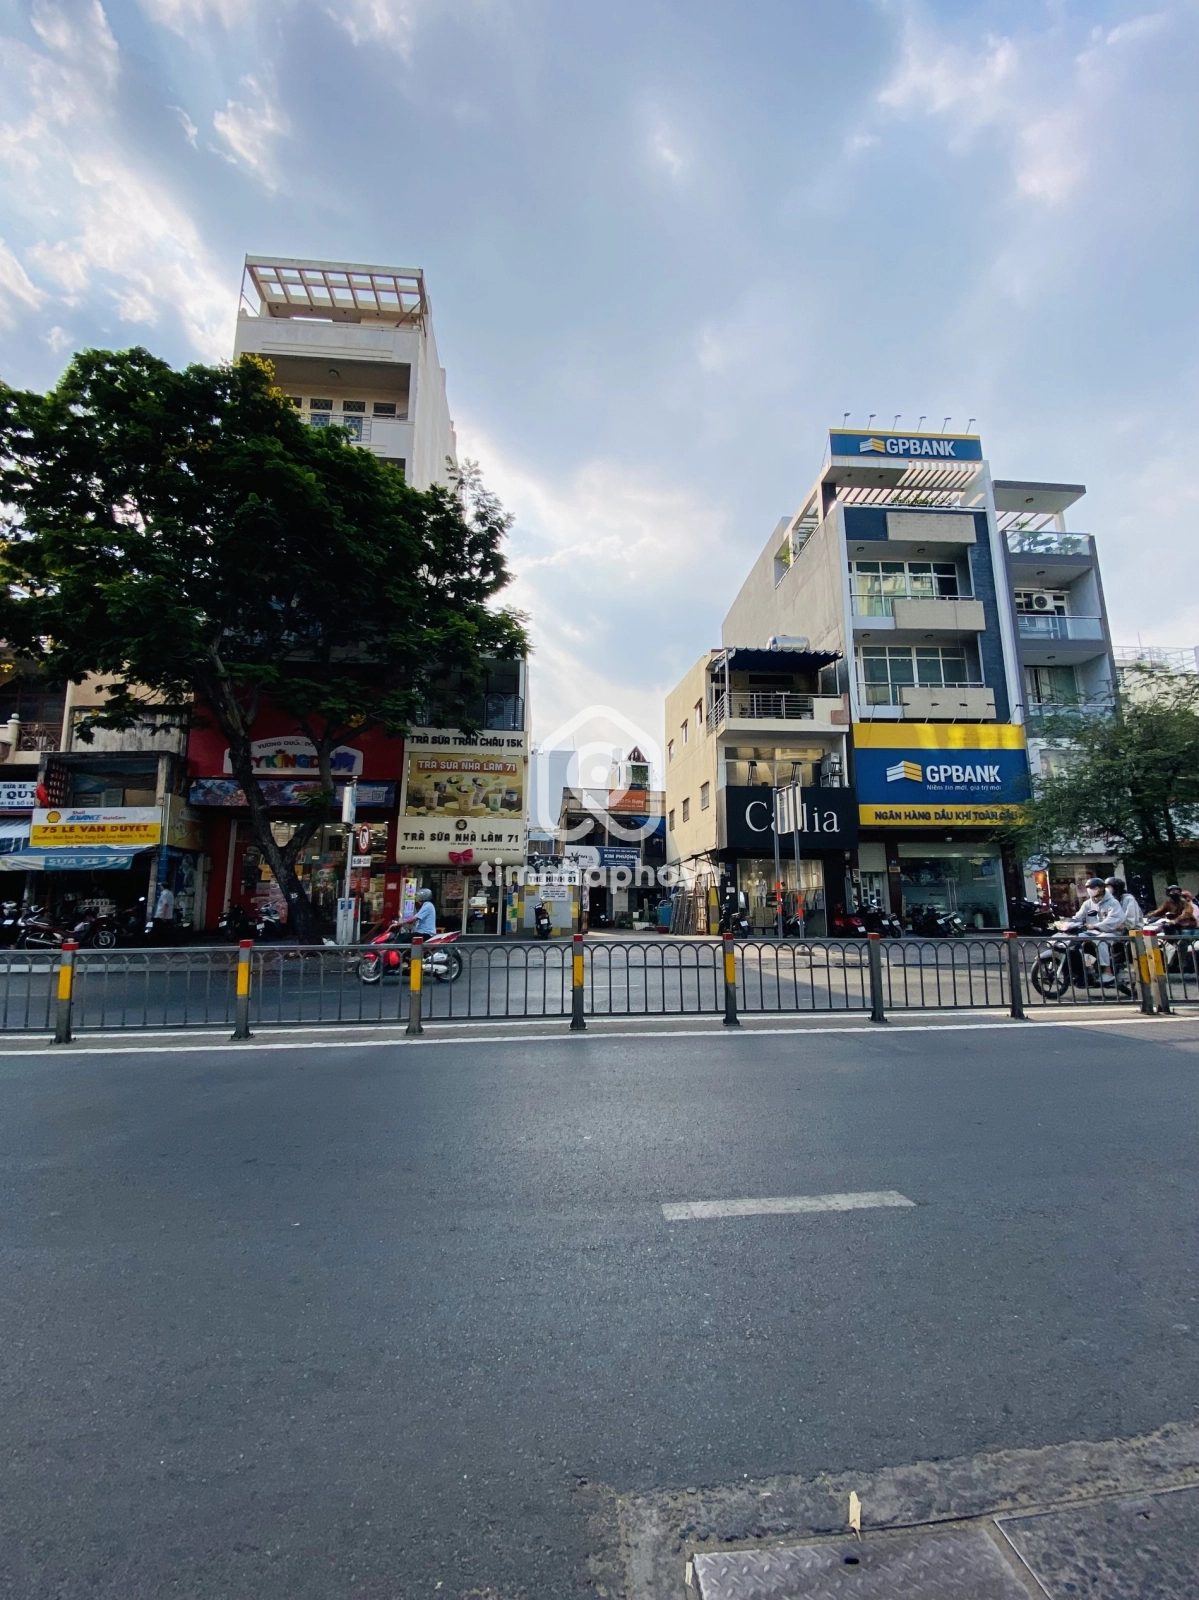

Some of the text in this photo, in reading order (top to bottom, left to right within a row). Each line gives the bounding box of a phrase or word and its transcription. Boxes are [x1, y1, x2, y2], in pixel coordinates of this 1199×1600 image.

[886, 438, 956, 457] GPBANK
[410, 733, 429, 744] TRÀ
[480, 737, 504, 747] CHÂU
[507, 739, 523, 748] 15K
[418, 757, 437, 769] TRÀ
[505, 763, 516, 771] 71
[926, 765, 1002, 783] GPBANK
[875, 809, 901, 820] NGÂN
[904, 809, 931, 820] HÀNG
[955, 809, 972, 820] KHÍ
[62, 825, 75, 833] LÊ
[403, 830, 519, 842] TRÀ SỮA NHÀ LÀM 71
